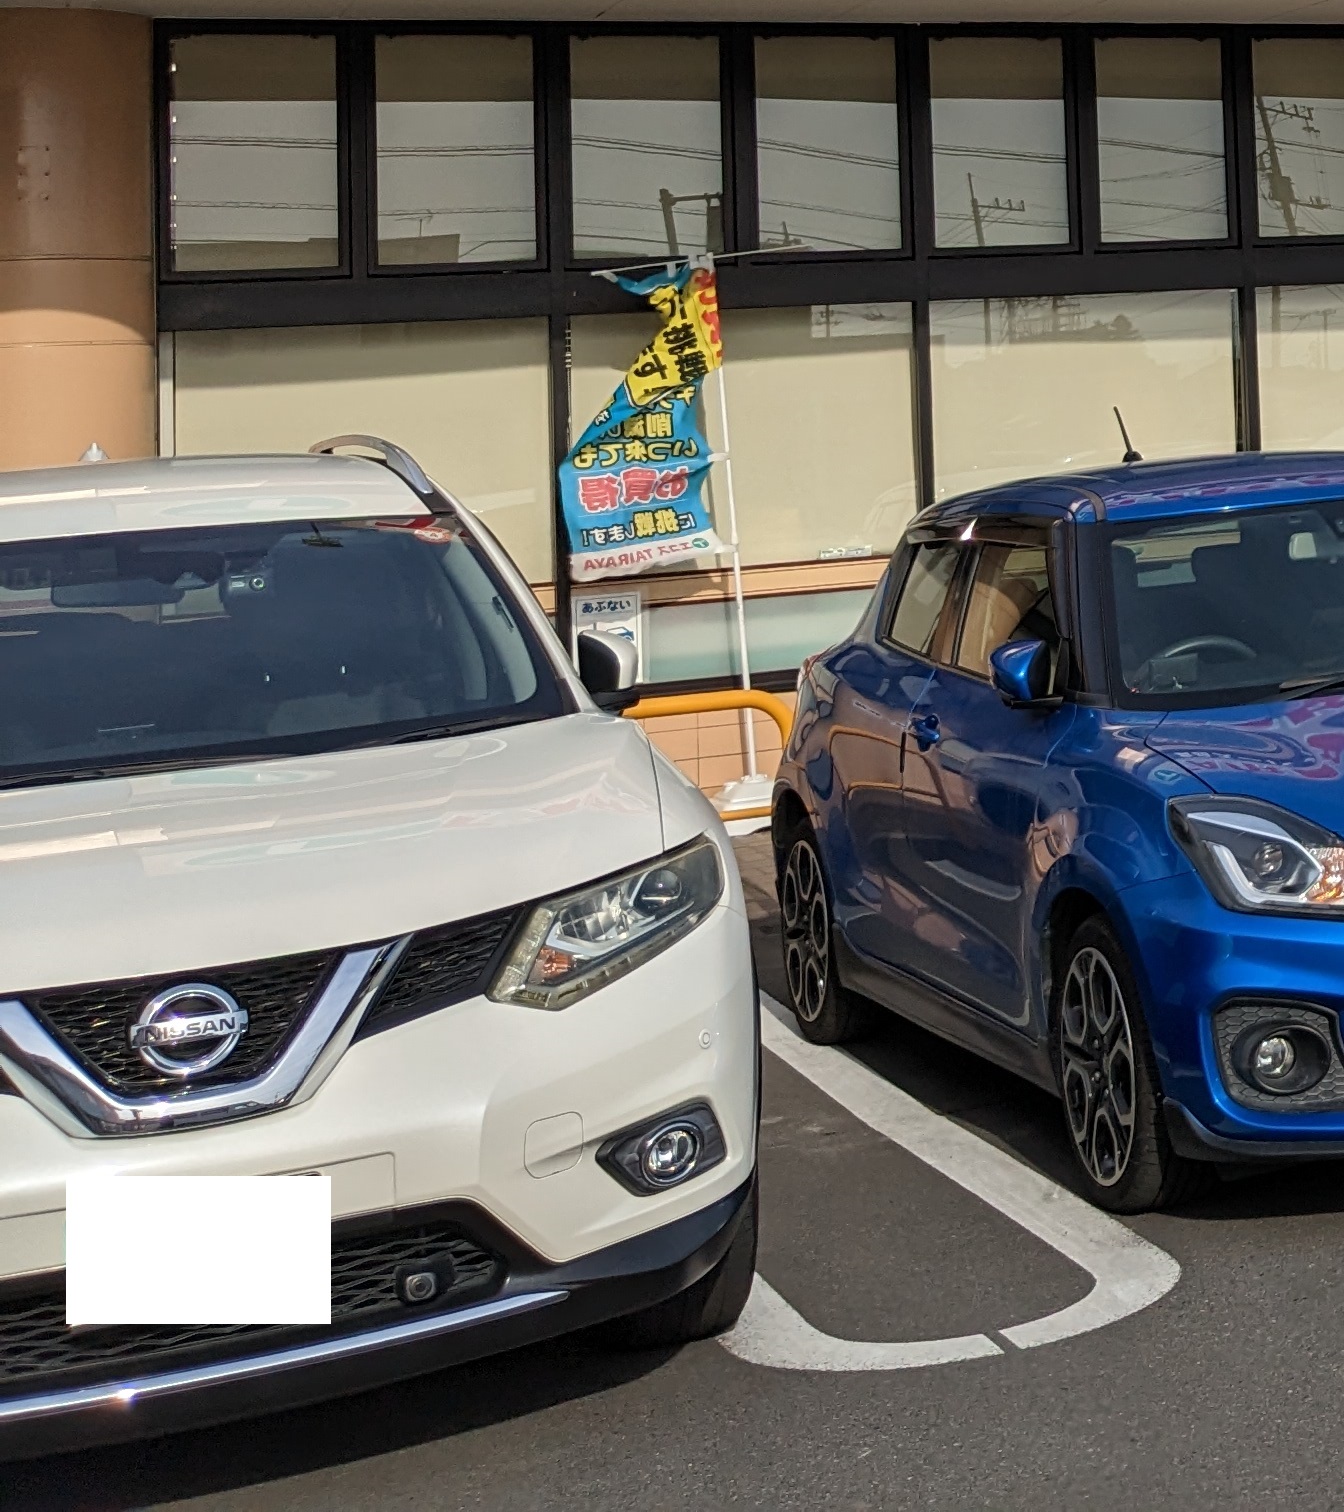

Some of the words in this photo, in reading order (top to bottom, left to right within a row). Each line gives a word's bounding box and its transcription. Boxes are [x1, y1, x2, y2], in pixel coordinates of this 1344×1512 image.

[581, 599, 631, 614] あぶない
[144, 1016, 236, 1042] NISSAN
